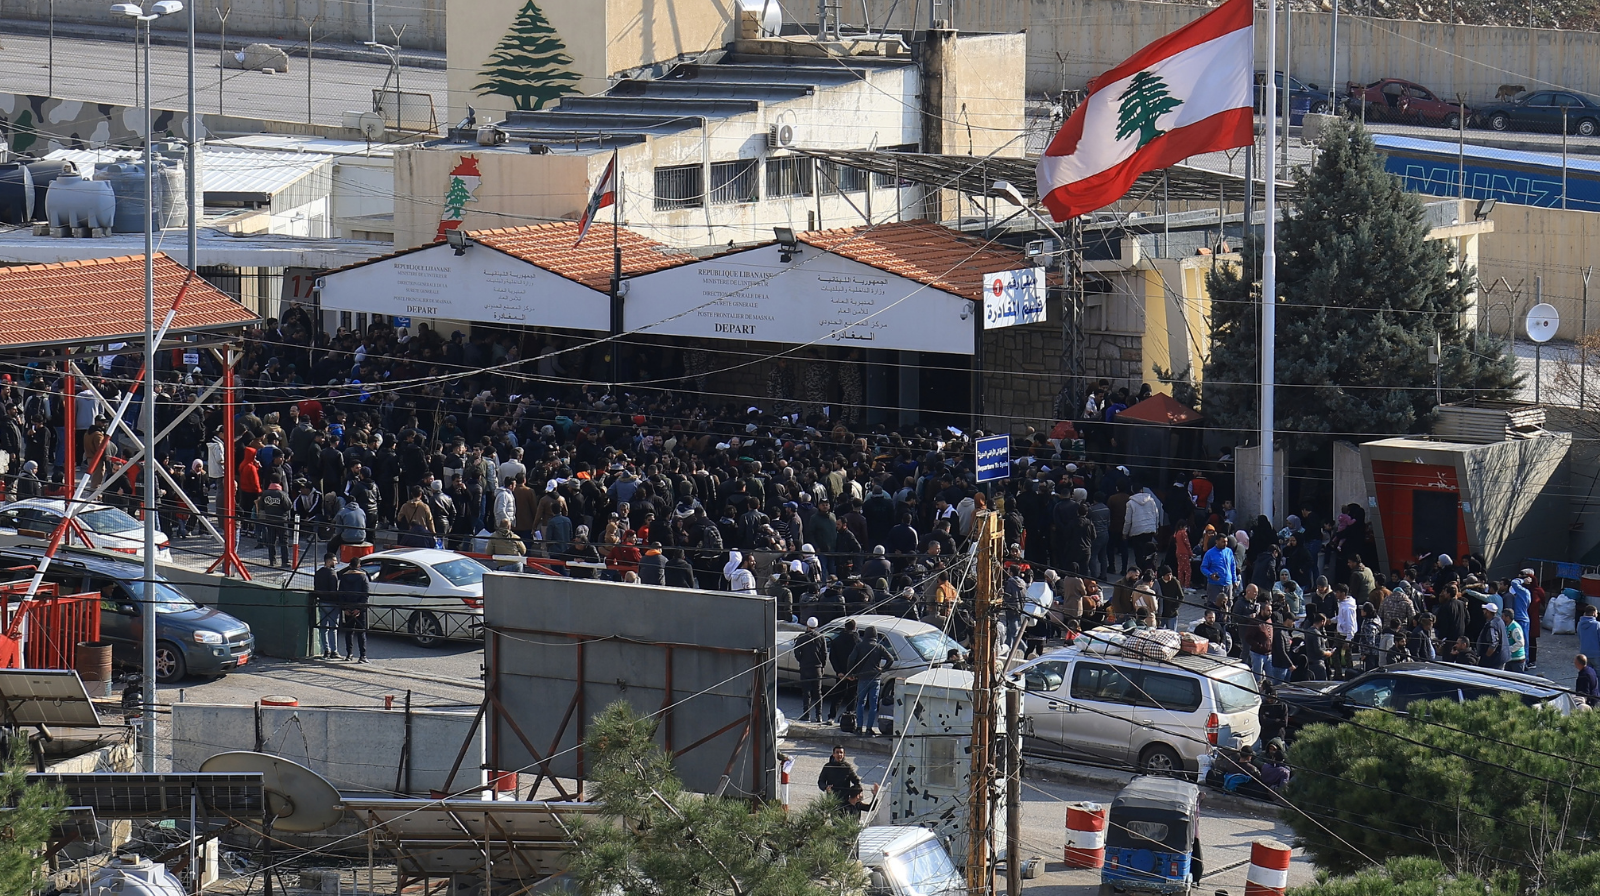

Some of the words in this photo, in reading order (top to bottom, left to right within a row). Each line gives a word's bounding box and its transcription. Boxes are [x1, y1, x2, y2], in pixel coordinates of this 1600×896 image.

[698, 268, 738, 279] REPUBLIQUE
[739, 270, 774, 280] LIBANAISE
[817, 274, 850, 284] اللبنانية
[291, 274, 315, 299] 17
[852, 276, 889, 286] الجمهورية
[406, 305, 438, 315] DEPART
[733, 301, 759, 309] GENERALE
[713, 312, 745, 320] FRONTALIER
[986, 299, 1020, 323] المغادرة
[714, 323, 756, 335] DEPART
[830, 329, 875, 341] المغادرة
